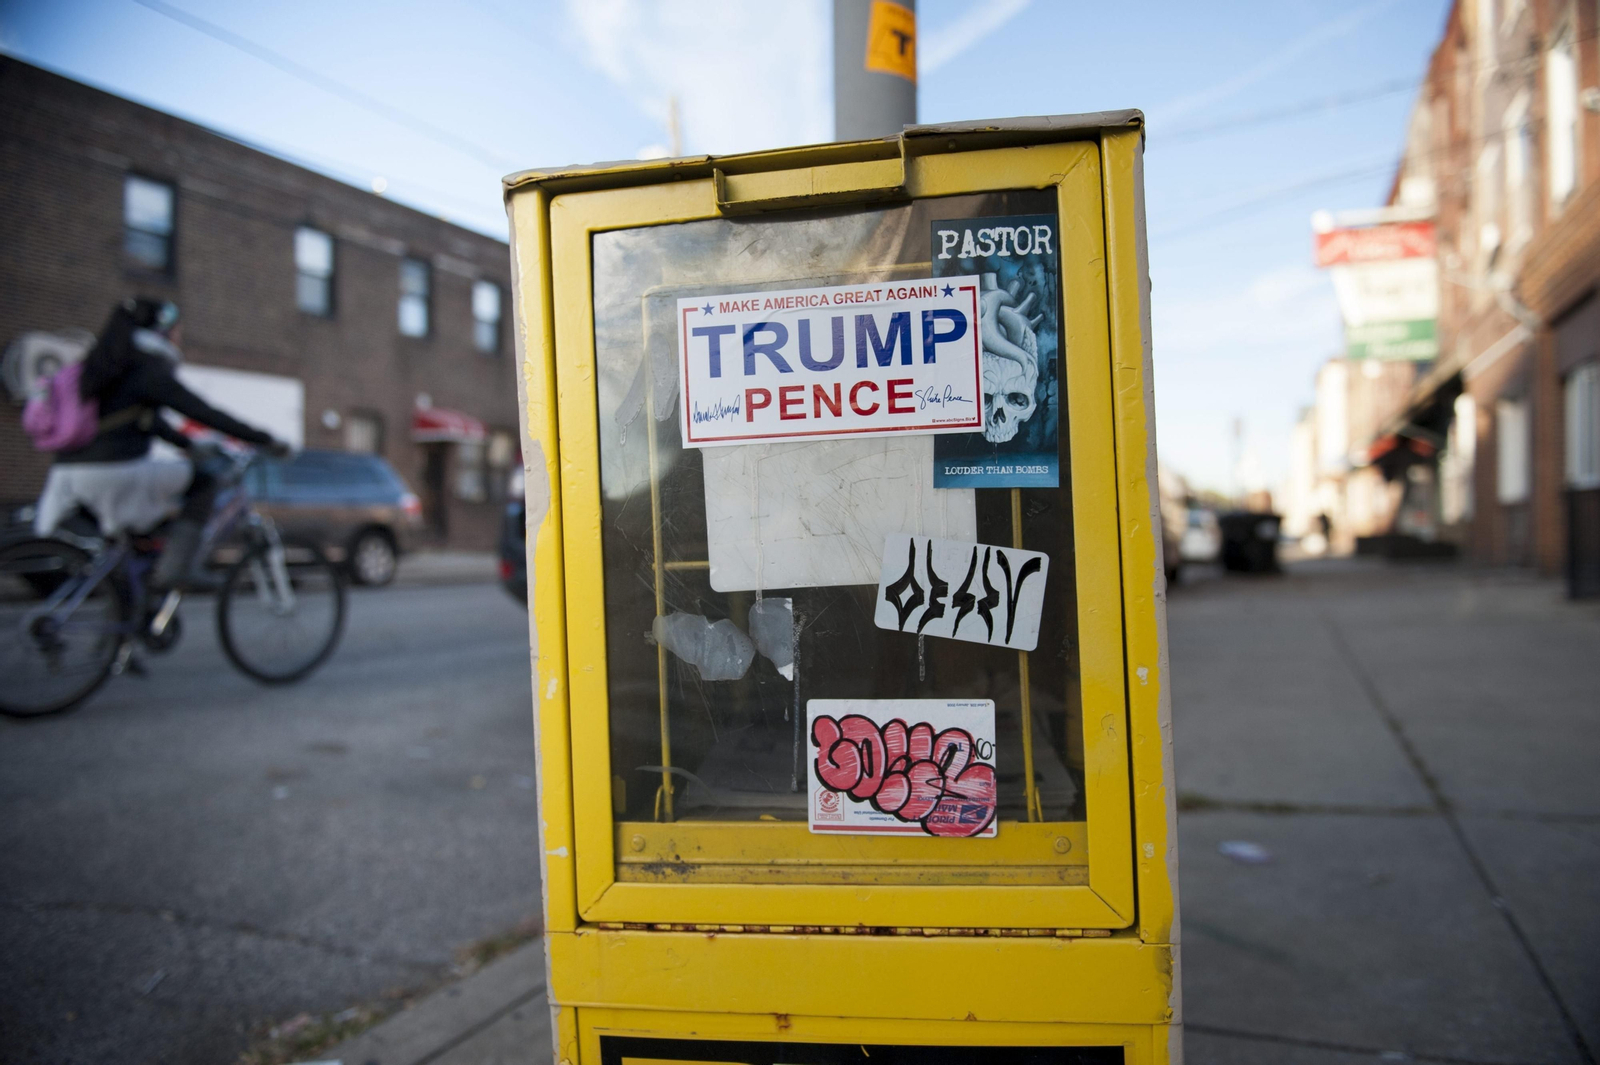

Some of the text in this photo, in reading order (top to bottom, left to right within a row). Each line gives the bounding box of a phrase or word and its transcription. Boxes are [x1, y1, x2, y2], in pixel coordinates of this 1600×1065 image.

[891, 28, 912, 56] T
[937, 225, 1053, 259] PASTOR
[719, 285, 937, 314] MAKE AMERICA GREAT AGAIN!
[692, 309, 967, 378] TRUMP
[745, 378, 915, 422] PENCE
[944, 465, 1049, 475] LOUDER THAN BOMBS
